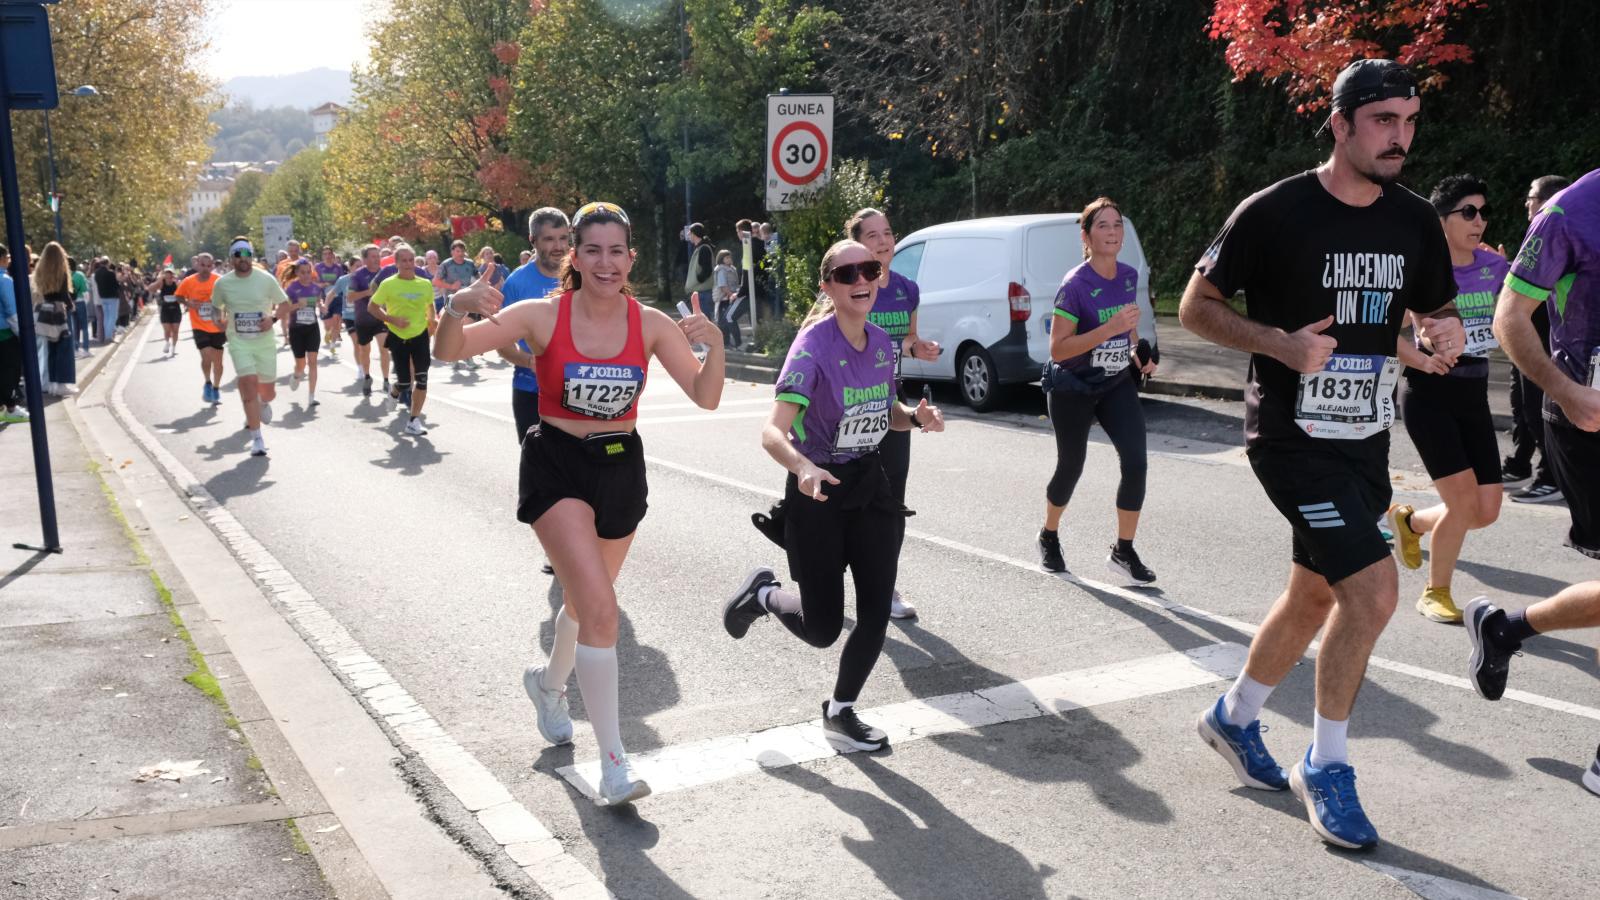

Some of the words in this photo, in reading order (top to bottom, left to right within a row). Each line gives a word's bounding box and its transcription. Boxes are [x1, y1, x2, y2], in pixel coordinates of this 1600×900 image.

[777, 103, 825, 115] GUNEA
[786, 144, 816, 164] 30
[1322, 252, 1405, 290] ¿HACEMOS
[1336, 290, 1359, 325] UN
[1362, 290, 1394, 325] TRI?
[571, 383, 635, 403] 17225
[1308, 376, 1374, 401] 18376
[843, 414, 888, 436] 17226
